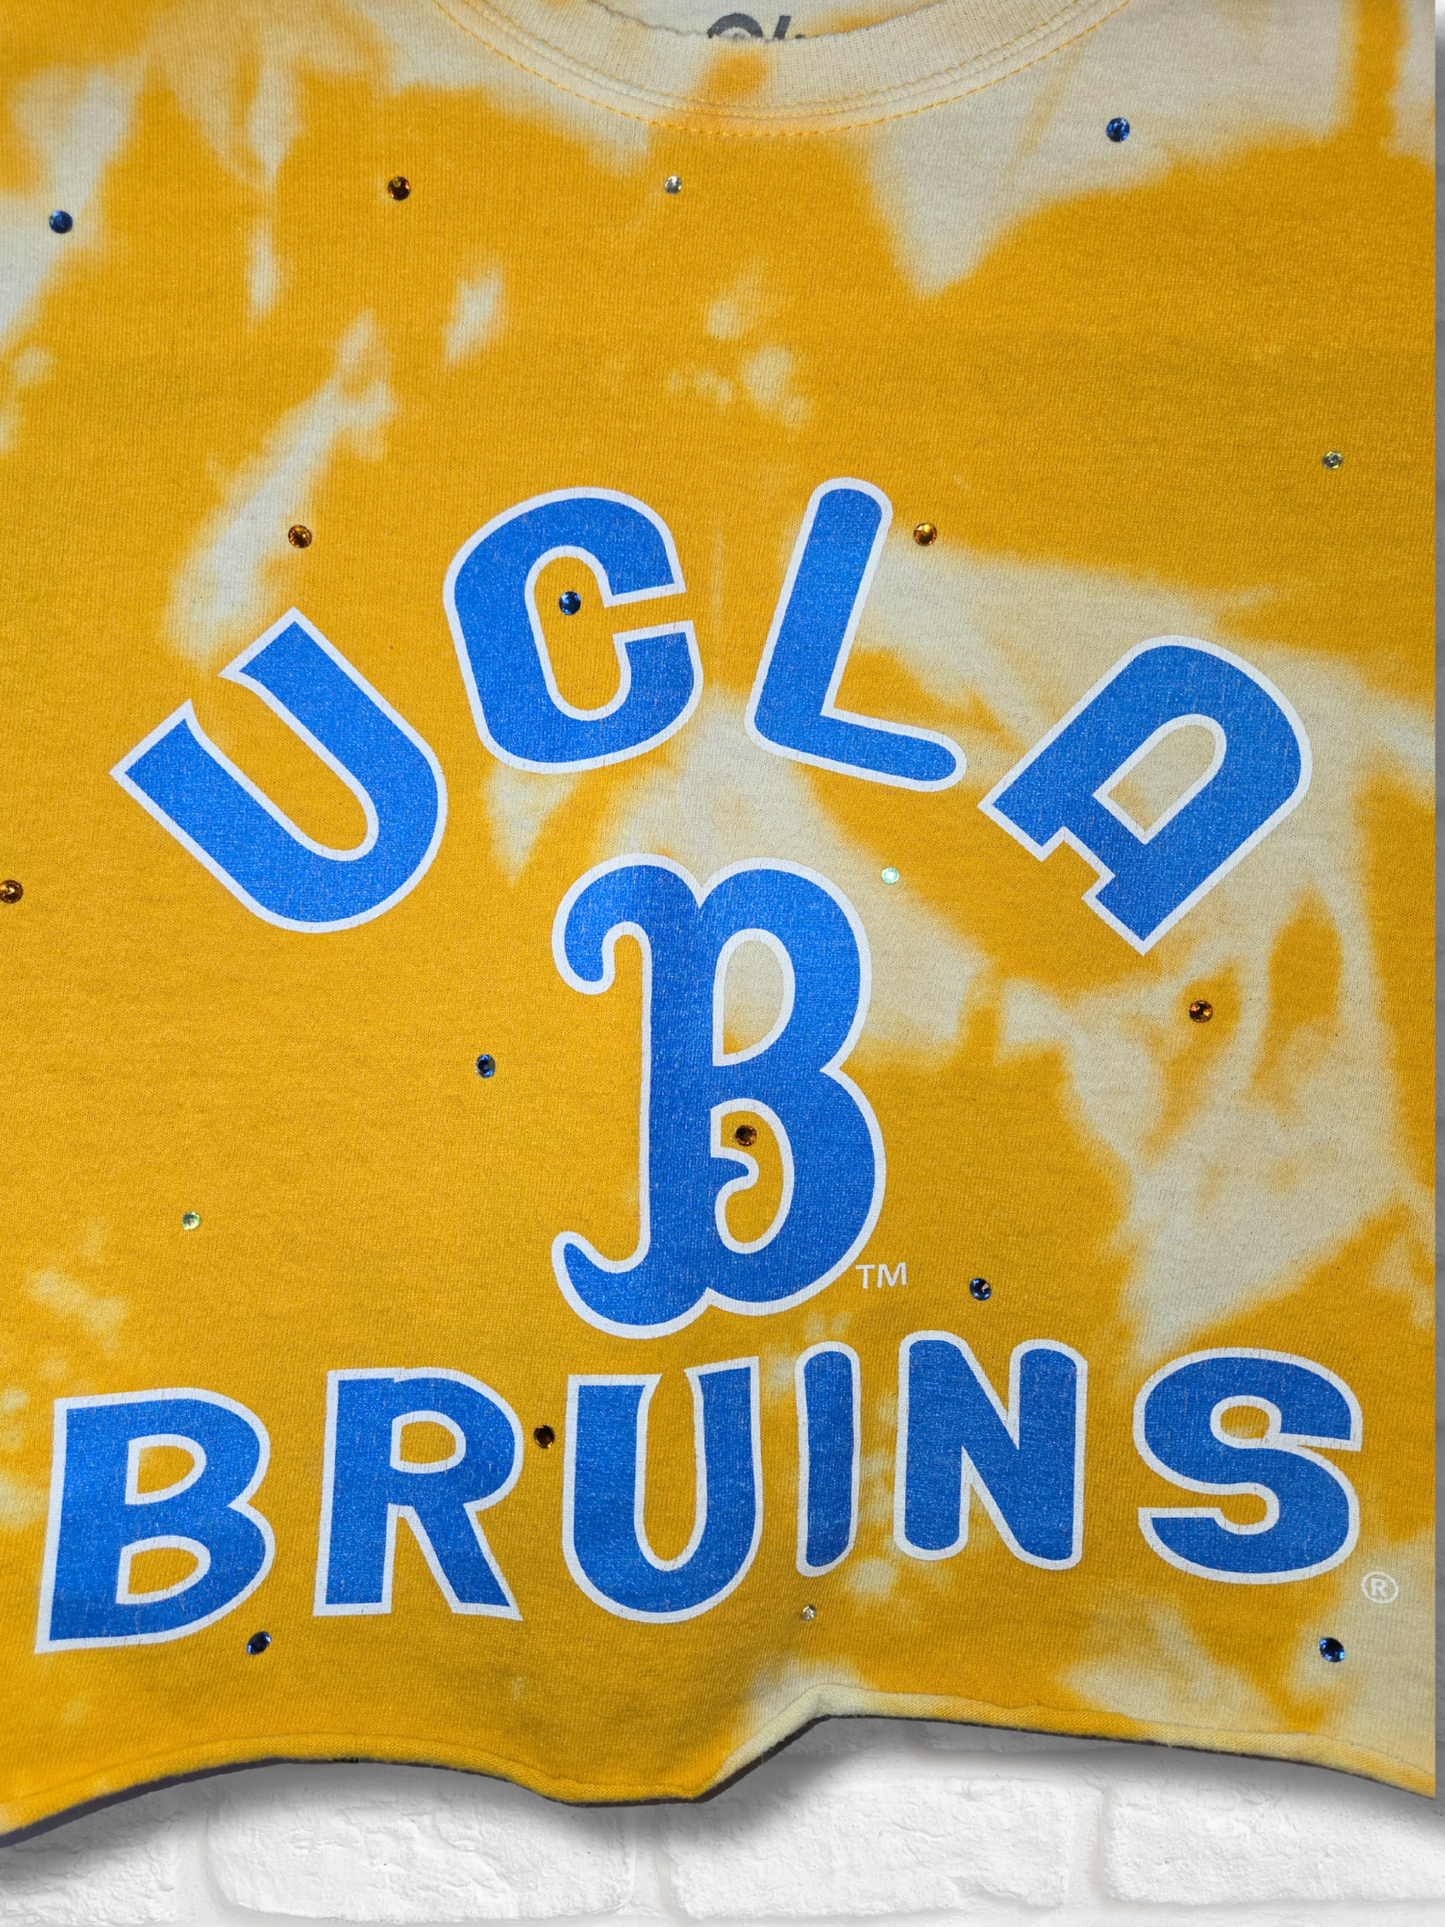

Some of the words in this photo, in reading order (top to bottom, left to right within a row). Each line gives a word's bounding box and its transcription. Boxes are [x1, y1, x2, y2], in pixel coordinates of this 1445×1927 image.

[111, 477, 1314, 955] UCLA
[550, 853, 888, 1340] B
[855, 1262, 907, 1289] TM
[34, 1330, 1364, 1654] BRUINS
